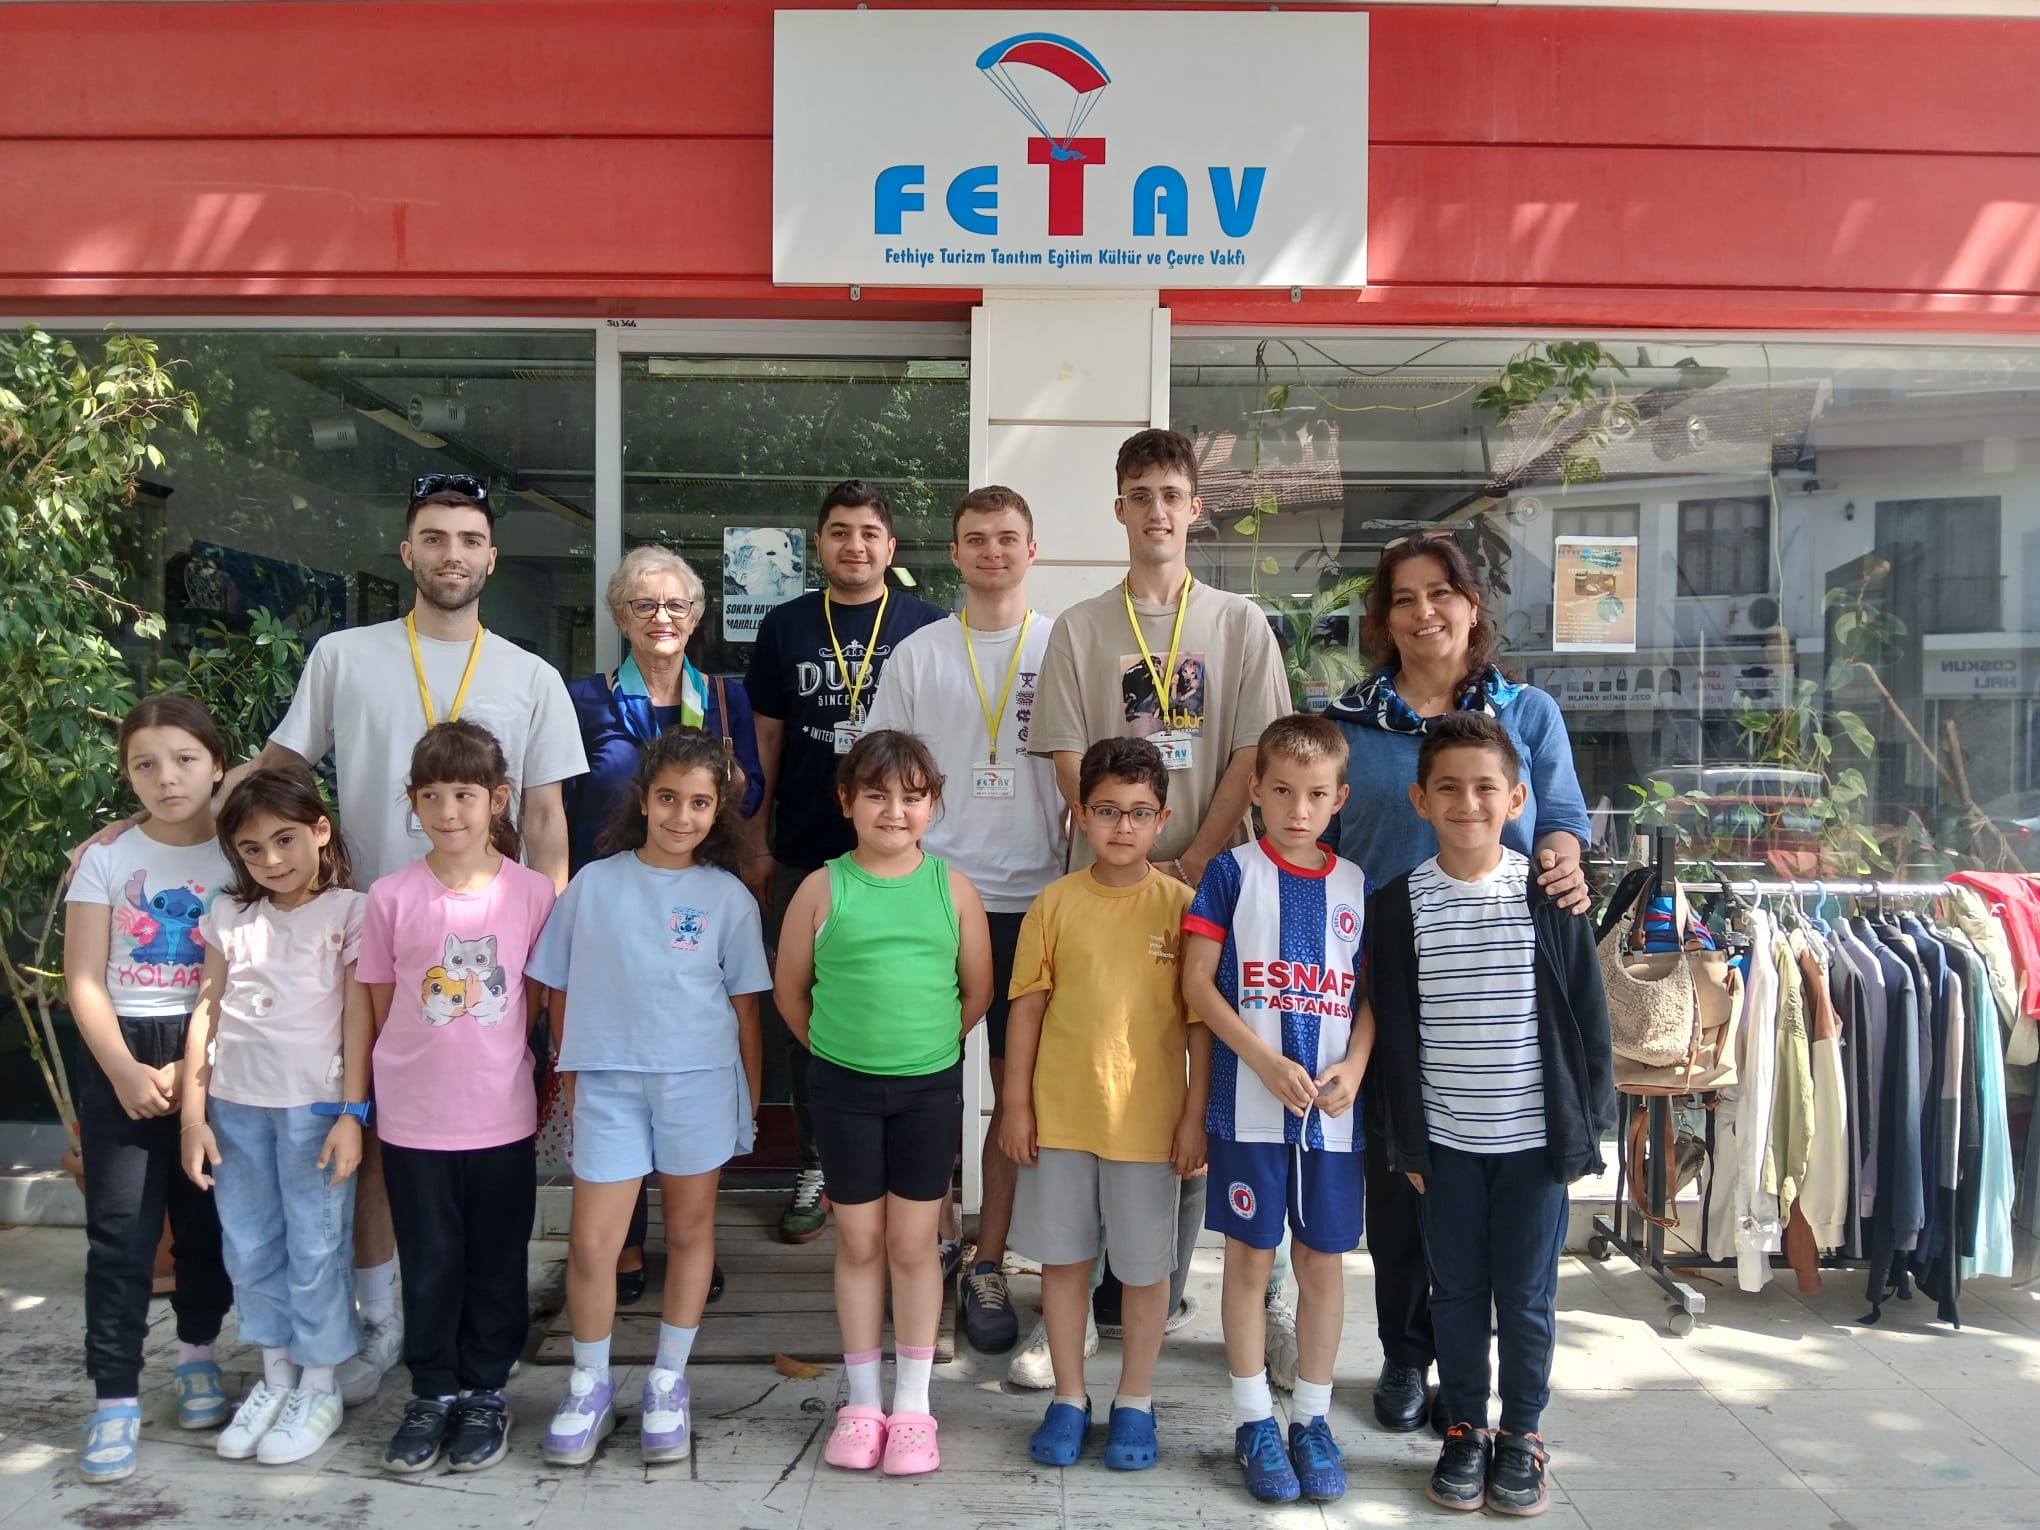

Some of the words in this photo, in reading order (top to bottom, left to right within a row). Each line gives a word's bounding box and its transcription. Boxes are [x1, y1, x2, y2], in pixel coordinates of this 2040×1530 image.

[874, 137, 1267, 238] FETAV
[885, 247, 935, 268] Fethiye
[939, 248, 986, 264] Turizm
[991, 248, 1042, 265] Tanıtım
[1099, 249, 1142, 265] Kültür
[1146, 254, 1161, 265] ve
[1166, 249, 1205, 269] Çevre
[1210, 249, 1246, 265] Vakfı
[726, 604, 753, 615] SOKAK
[818, 694, 850, 707] SINCE
[1243, 961, 1354, 997] ESNAF
